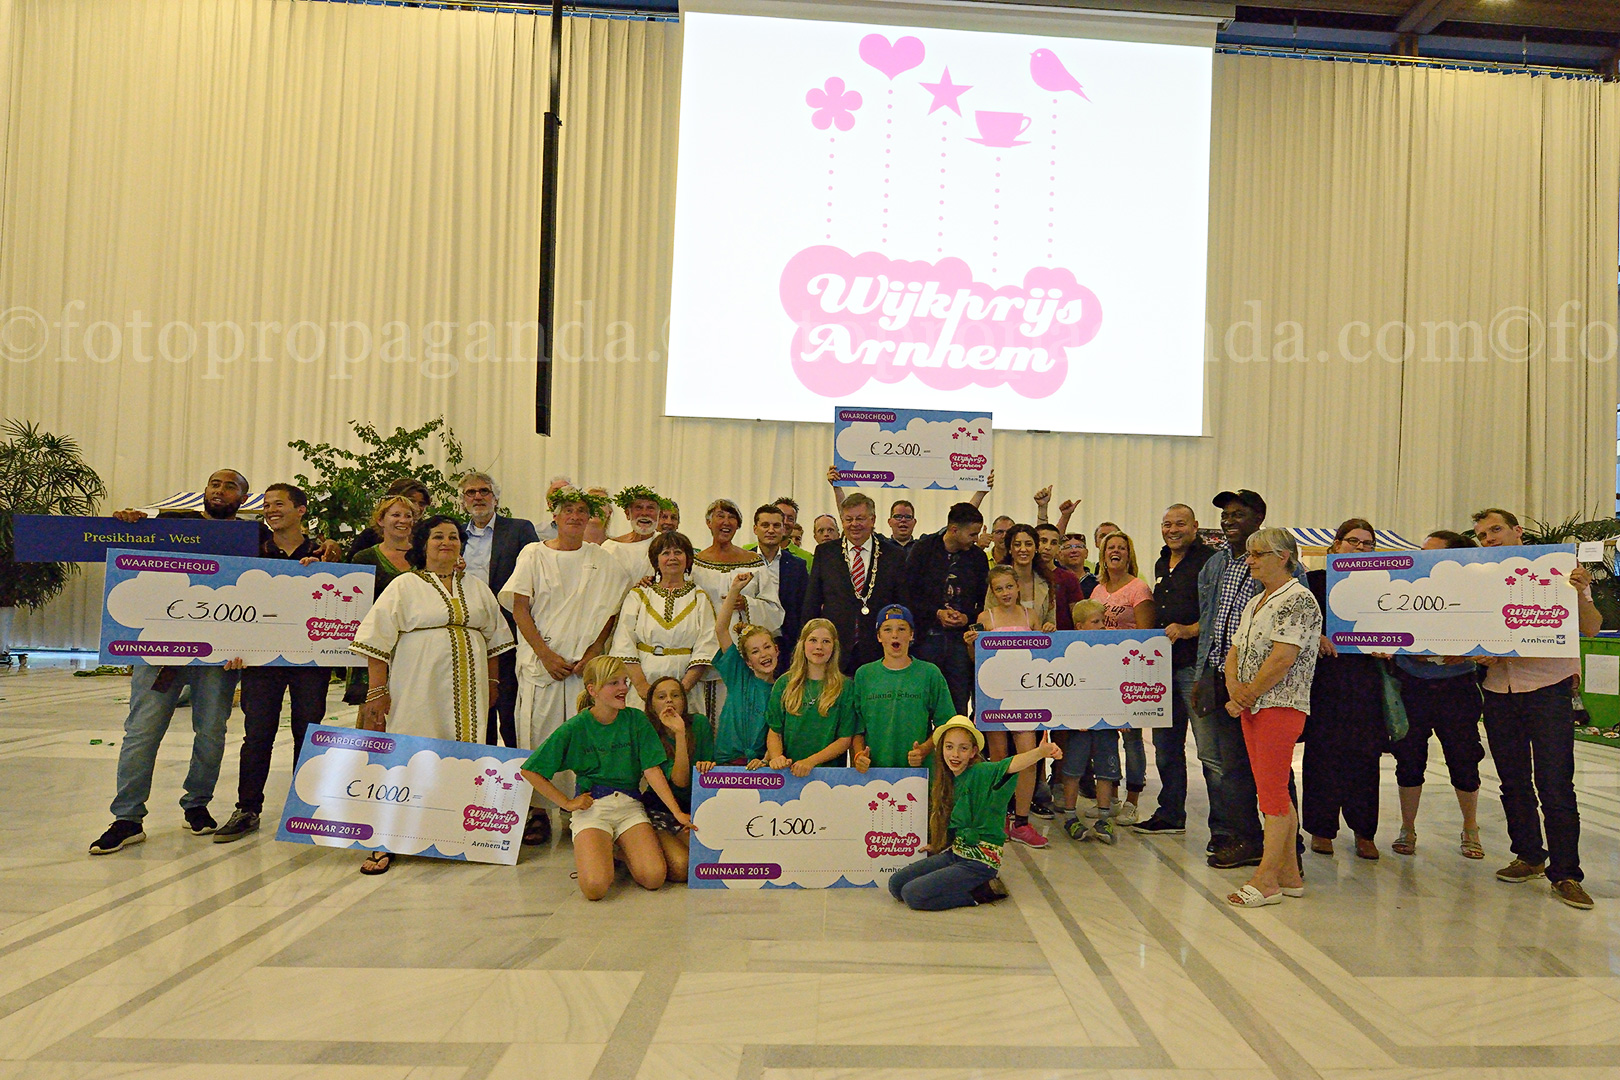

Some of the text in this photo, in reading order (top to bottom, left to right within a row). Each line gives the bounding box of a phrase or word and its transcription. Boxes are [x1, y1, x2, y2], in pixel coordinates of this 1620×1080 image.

[800, 323, 1056, 374] Arnhem
[842, 412, 894, 420] WAARDECHEQUE
[83, 532, 156, 544] Presikhaaf
[169, 534, 201, 544] West
[120, 558, 216, 572] WAARDECHEQUE
[1336, 558, 1411, 569] WAARDECHEQUE
[1377, 593, 1392, 612] €
[166, 600, 184, 620] €
[1508, 608, 1566, 618] Wijkprijs
[1507, 616, 1560, 624] Arnhem
[114, 644, 199, 654] WINNAAR 2015
[1020, 672, 1034, 688] €
[984, 712, 1042, 720] WINNAAR 2015
[315, 734, 393, 751] WAARDECHEQUE
[702, 776, 782, 786] WAARDECHEQUE
[346, 779, 361, 798] €
[290, 820, 362, 836] WINNAAR 2015
[464, 818, 508, 830] Arnhem
[746, 815, 764, 838] €
[472, 840, 500, 850] Arnhem
[868, 844, 912, 852] Arnhem
[699, 867, 770, 876] WINNAAR 2015
